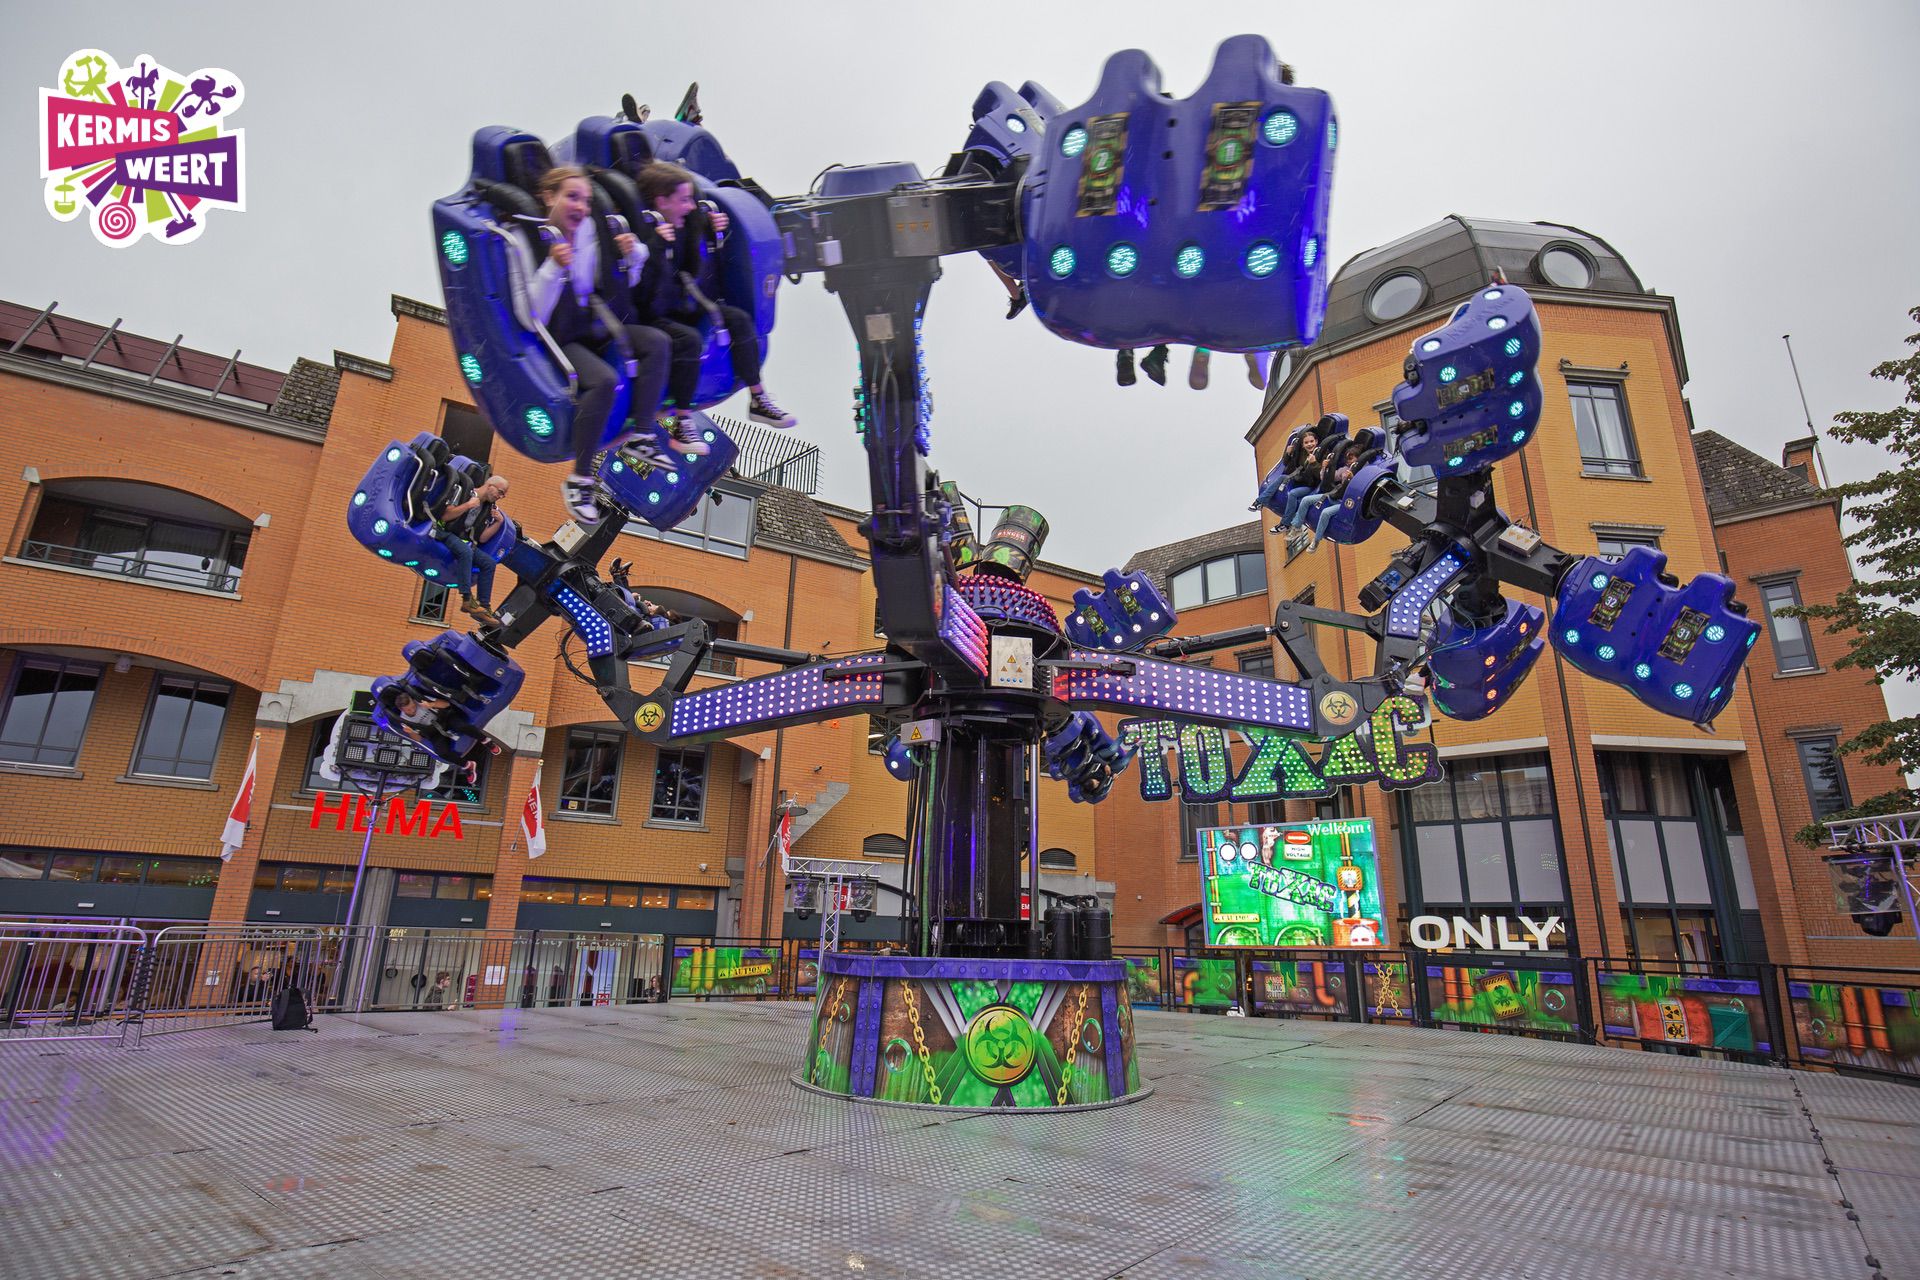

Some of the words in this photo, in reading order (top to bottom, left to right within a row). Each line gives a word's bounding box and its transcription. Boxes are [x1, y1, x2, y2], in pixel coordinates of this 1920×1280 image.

[1095, 152, 1107, 171] 2
[1224, 142, 1236, 162] 1
[1605, 596, 1618, 608] 32
[1677, 628, 1690, 641] 31
[309, 791, 464, 840] HEMA
[1306, 823, 1364, 837] Welkom
[1409, 915, 1561, 951] ONLY
